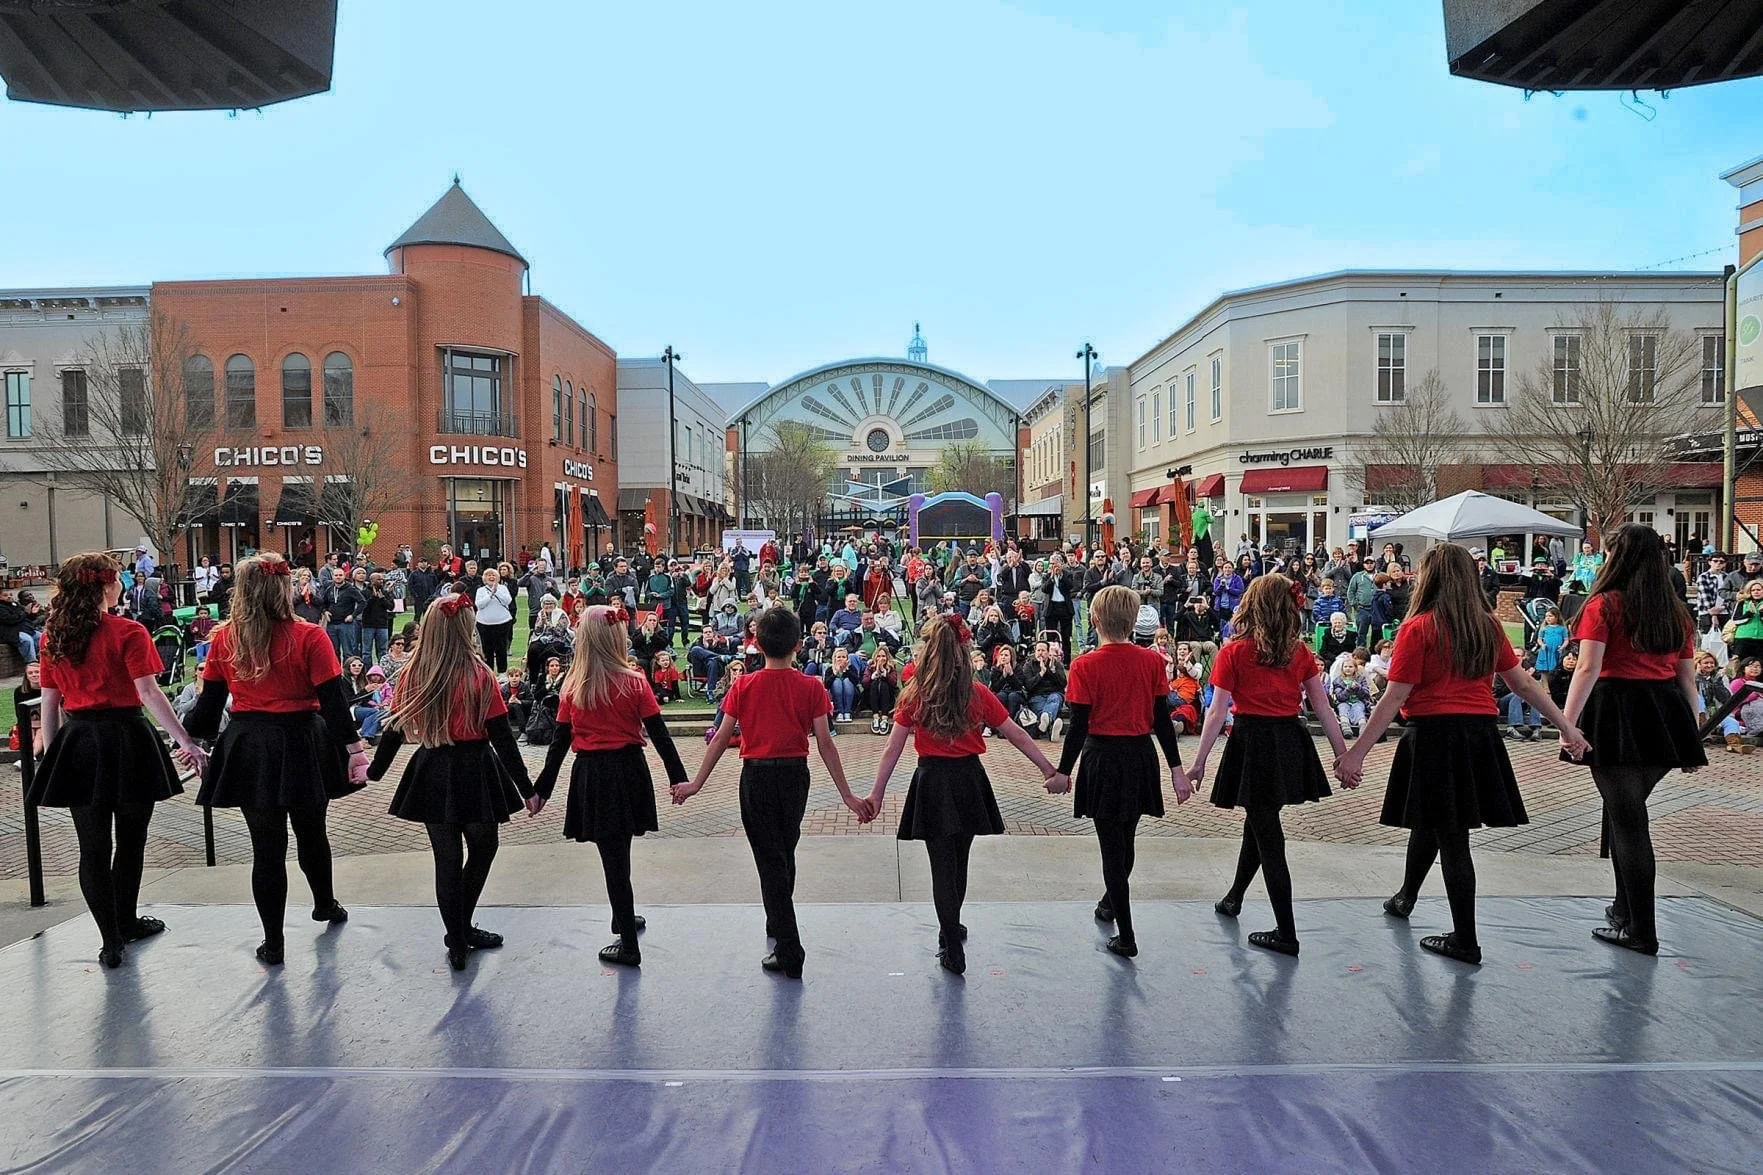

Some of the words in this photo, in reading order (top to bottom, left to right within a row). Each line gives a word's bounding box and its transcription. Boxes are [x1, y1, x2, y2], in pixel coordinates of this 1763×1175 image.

[214, 444, 323, 466] CHICO'S
[429, 445, 527, 468] CHICO'S
[875, 454, 910, 462] PAVILION
[1239, 451, 1289, 466] charming
[1290, 447, 1333, 460] CHARLIE
[564, 458, 593, 481] CHICO'S
